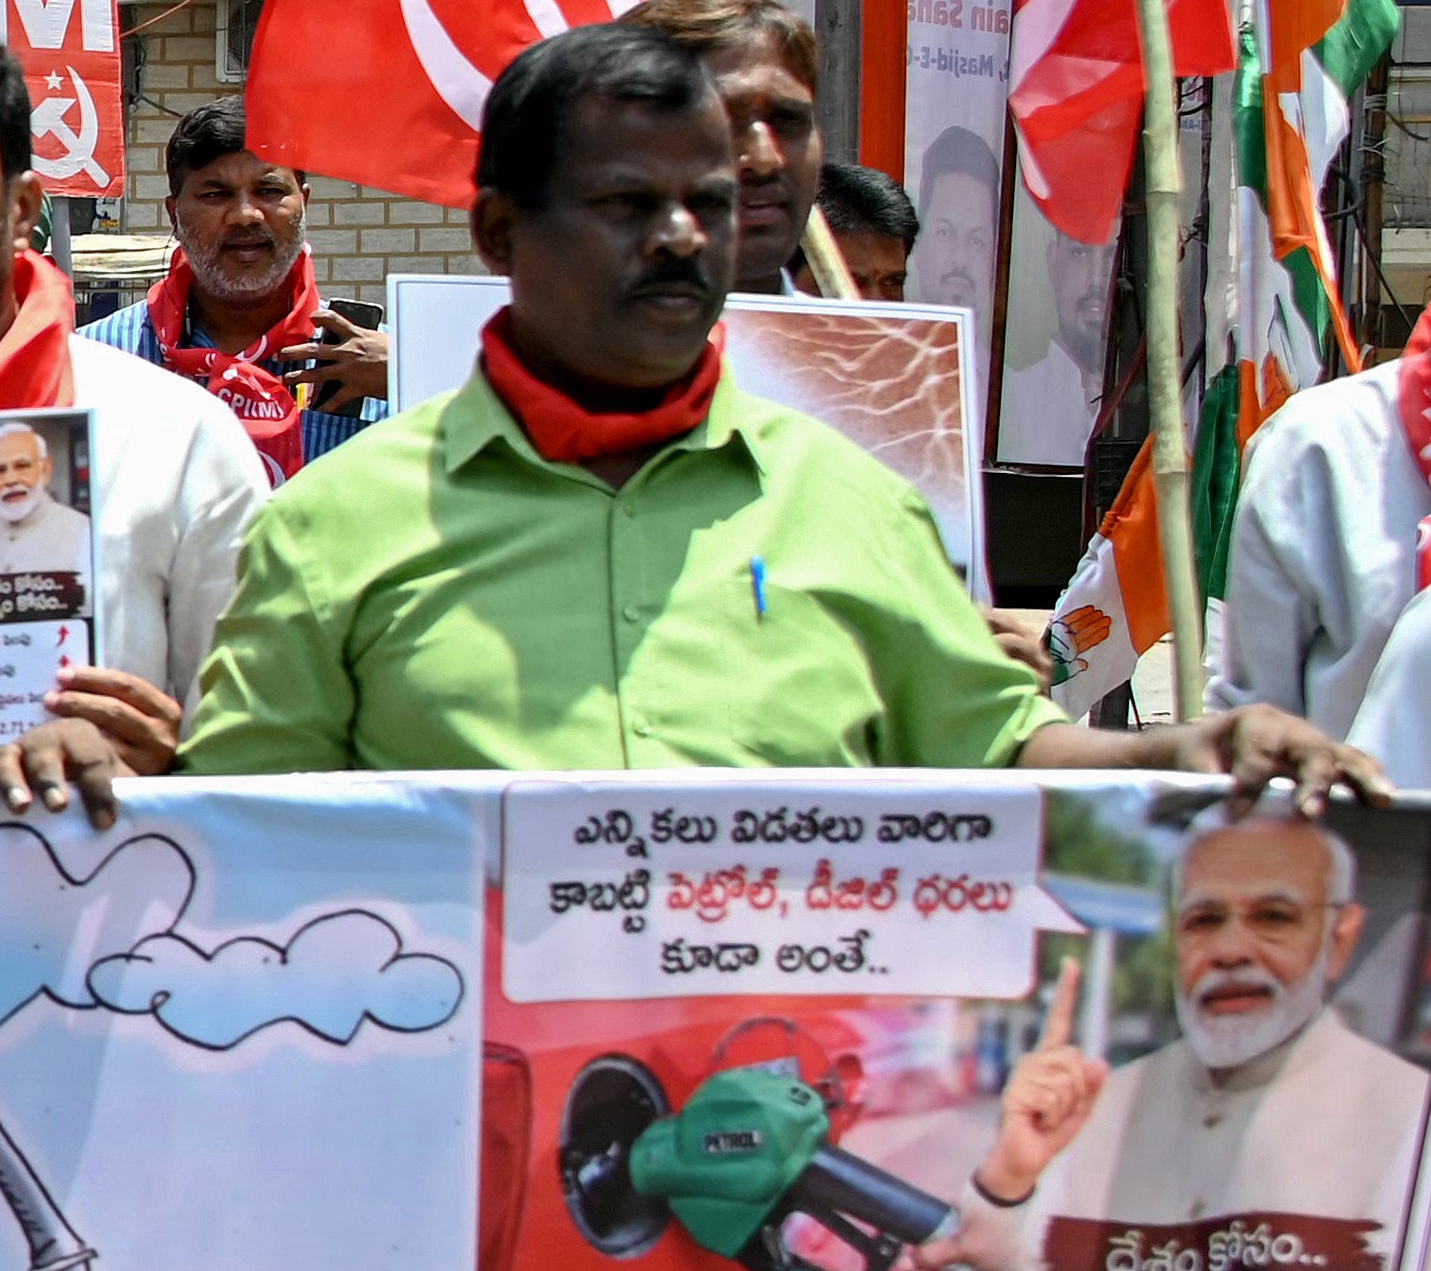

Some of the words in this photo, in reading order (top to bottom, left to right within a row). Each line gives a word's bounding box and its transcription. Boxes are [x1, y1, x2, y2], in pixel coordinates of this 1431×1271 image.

[730, 806, 863, 845] విడతలు
[878, 810, 993, 845] వారిగా
[548, 867, 651, 933] కాబట్టి
[805, 858, 899, 913] డీజిల్
[913, 872, 1013, 917] ధరలు
[661, 937, 760, 975] కూడా
[703, 1130, 760, 1153] PETROL
